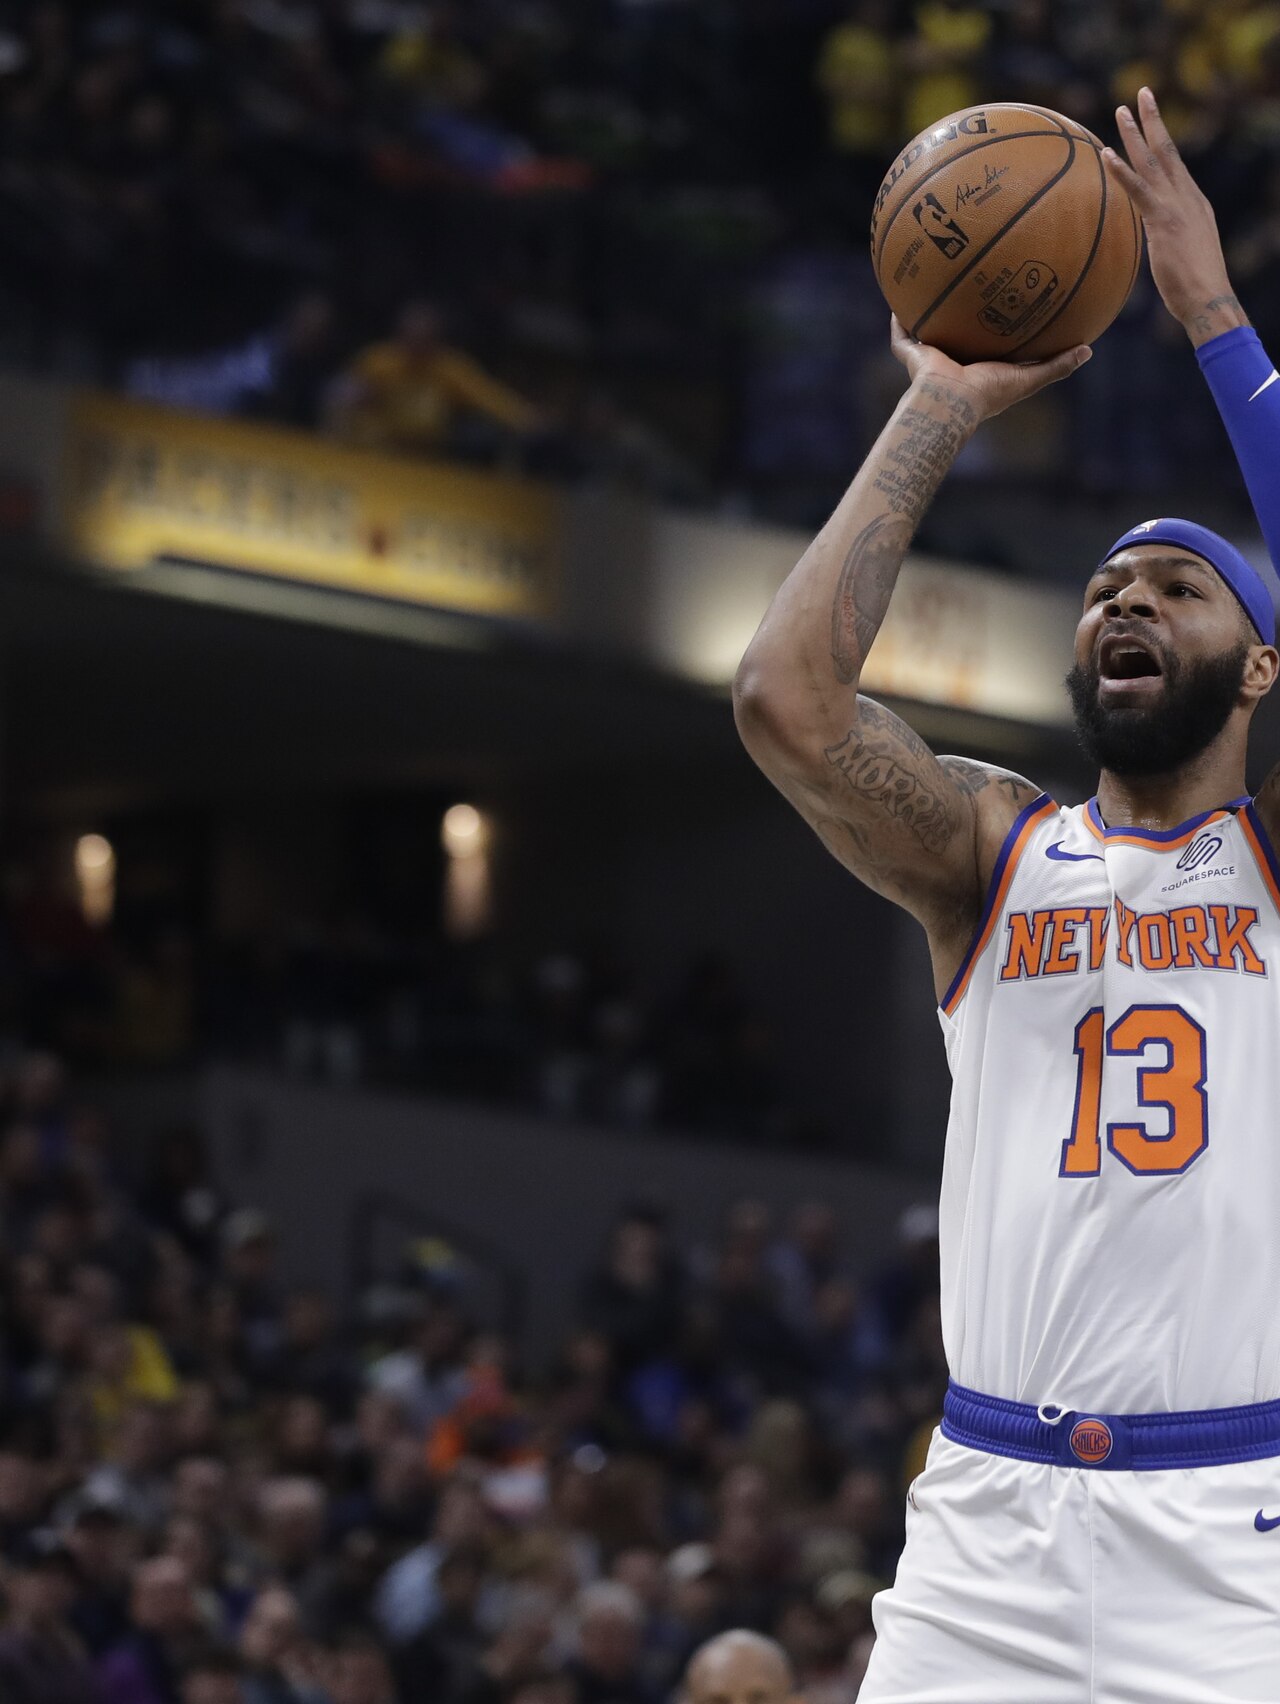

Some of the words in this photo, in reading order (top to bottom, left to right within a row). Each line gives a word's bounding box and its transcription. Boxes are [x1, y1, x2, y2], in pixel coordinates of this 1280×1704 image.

[1161, 866, 1236, 893] SQUARESPACE
[1113, 892, 1269, 979] YORK
[1058, 1003, 1209, 1178] 13
[1074, 1431, 1108, 1453] KNICKS
